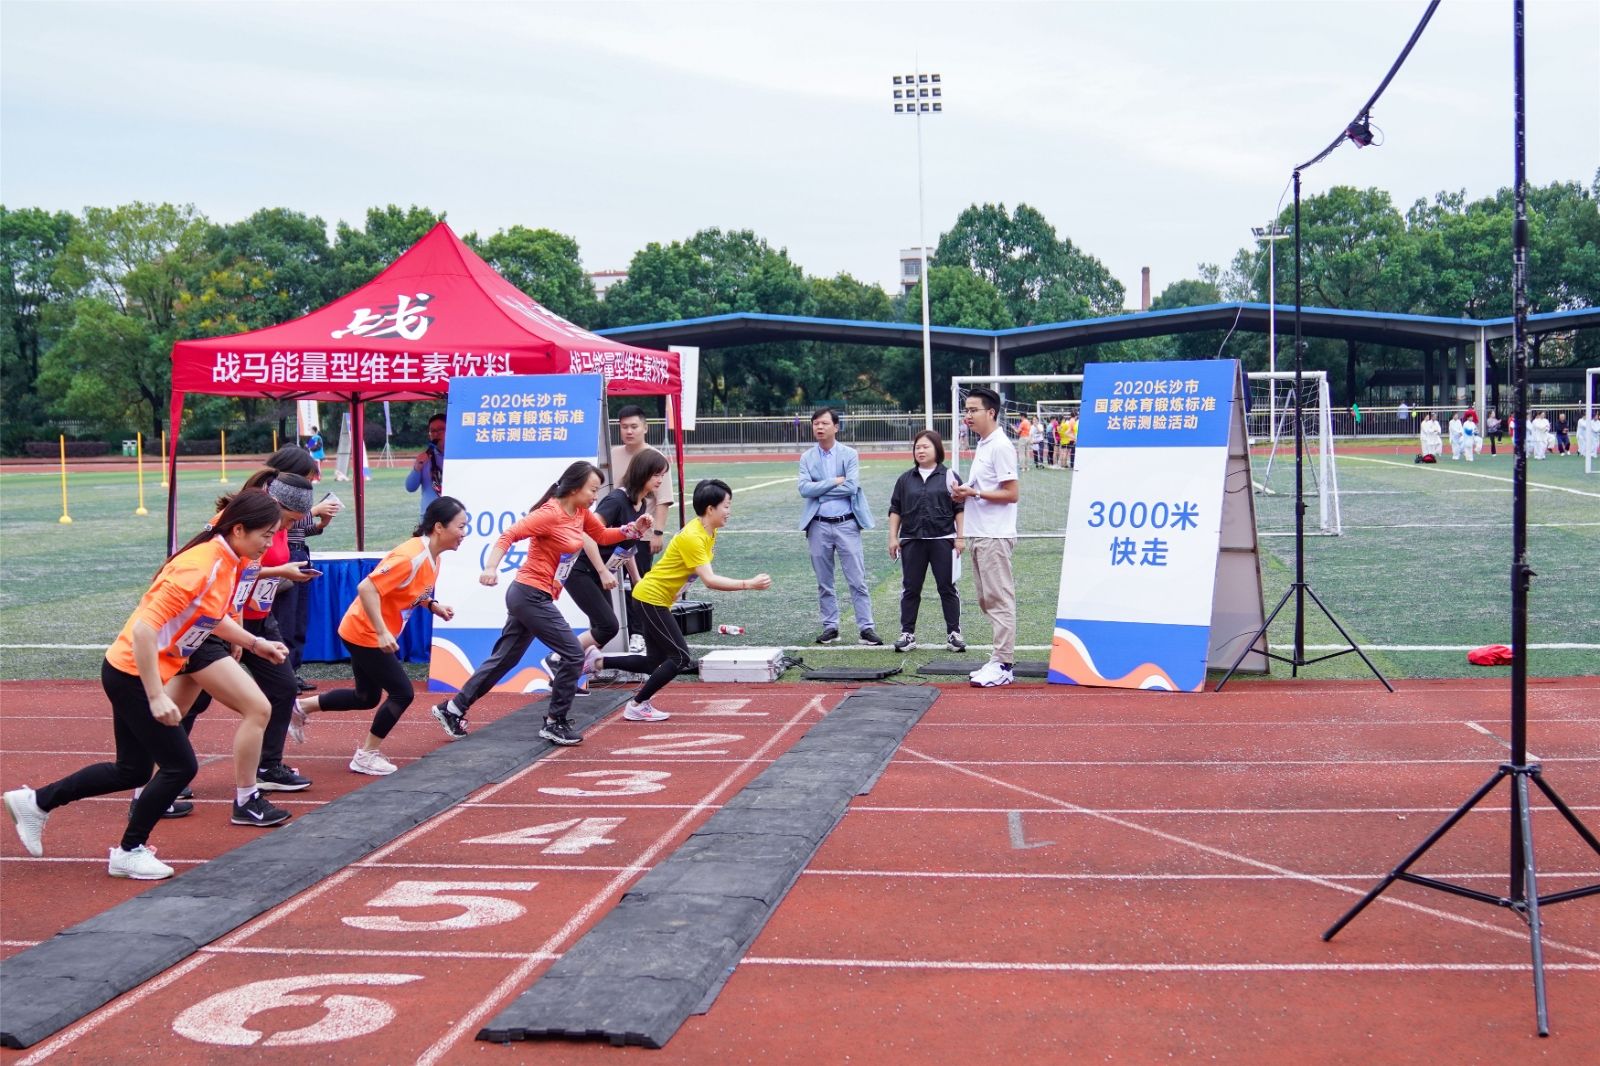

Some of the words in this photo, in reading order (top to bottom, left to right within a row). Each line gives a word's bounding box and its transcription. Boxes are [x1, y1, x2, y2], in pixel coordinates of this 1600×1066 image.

[212, 352, 515, 384] 战马能量型维生素饮料
[1113, 379, 1200, 395] 2020长沙市
[480, 393, 568, 408] 2020长沙市
[1094, 396, 1216, 413] 国家体育锻炼标准
[461, 409, 585, 426] 国家体育锻炼标准
[1106, 414, 1199, 430] 达标测验活动
[475, 426, 568, 442] 达标测验活动
[1087, 501, 1200, 531] 3000米
[1109, 536, 1169, 566] 快走
[610, 733, 746, 755] 2
[537, 769, 672, 796] 3
[459, 817, 627, 855] 4
[341, 881, 540, 931] 5
[172, 973, 426, 1046] 6
